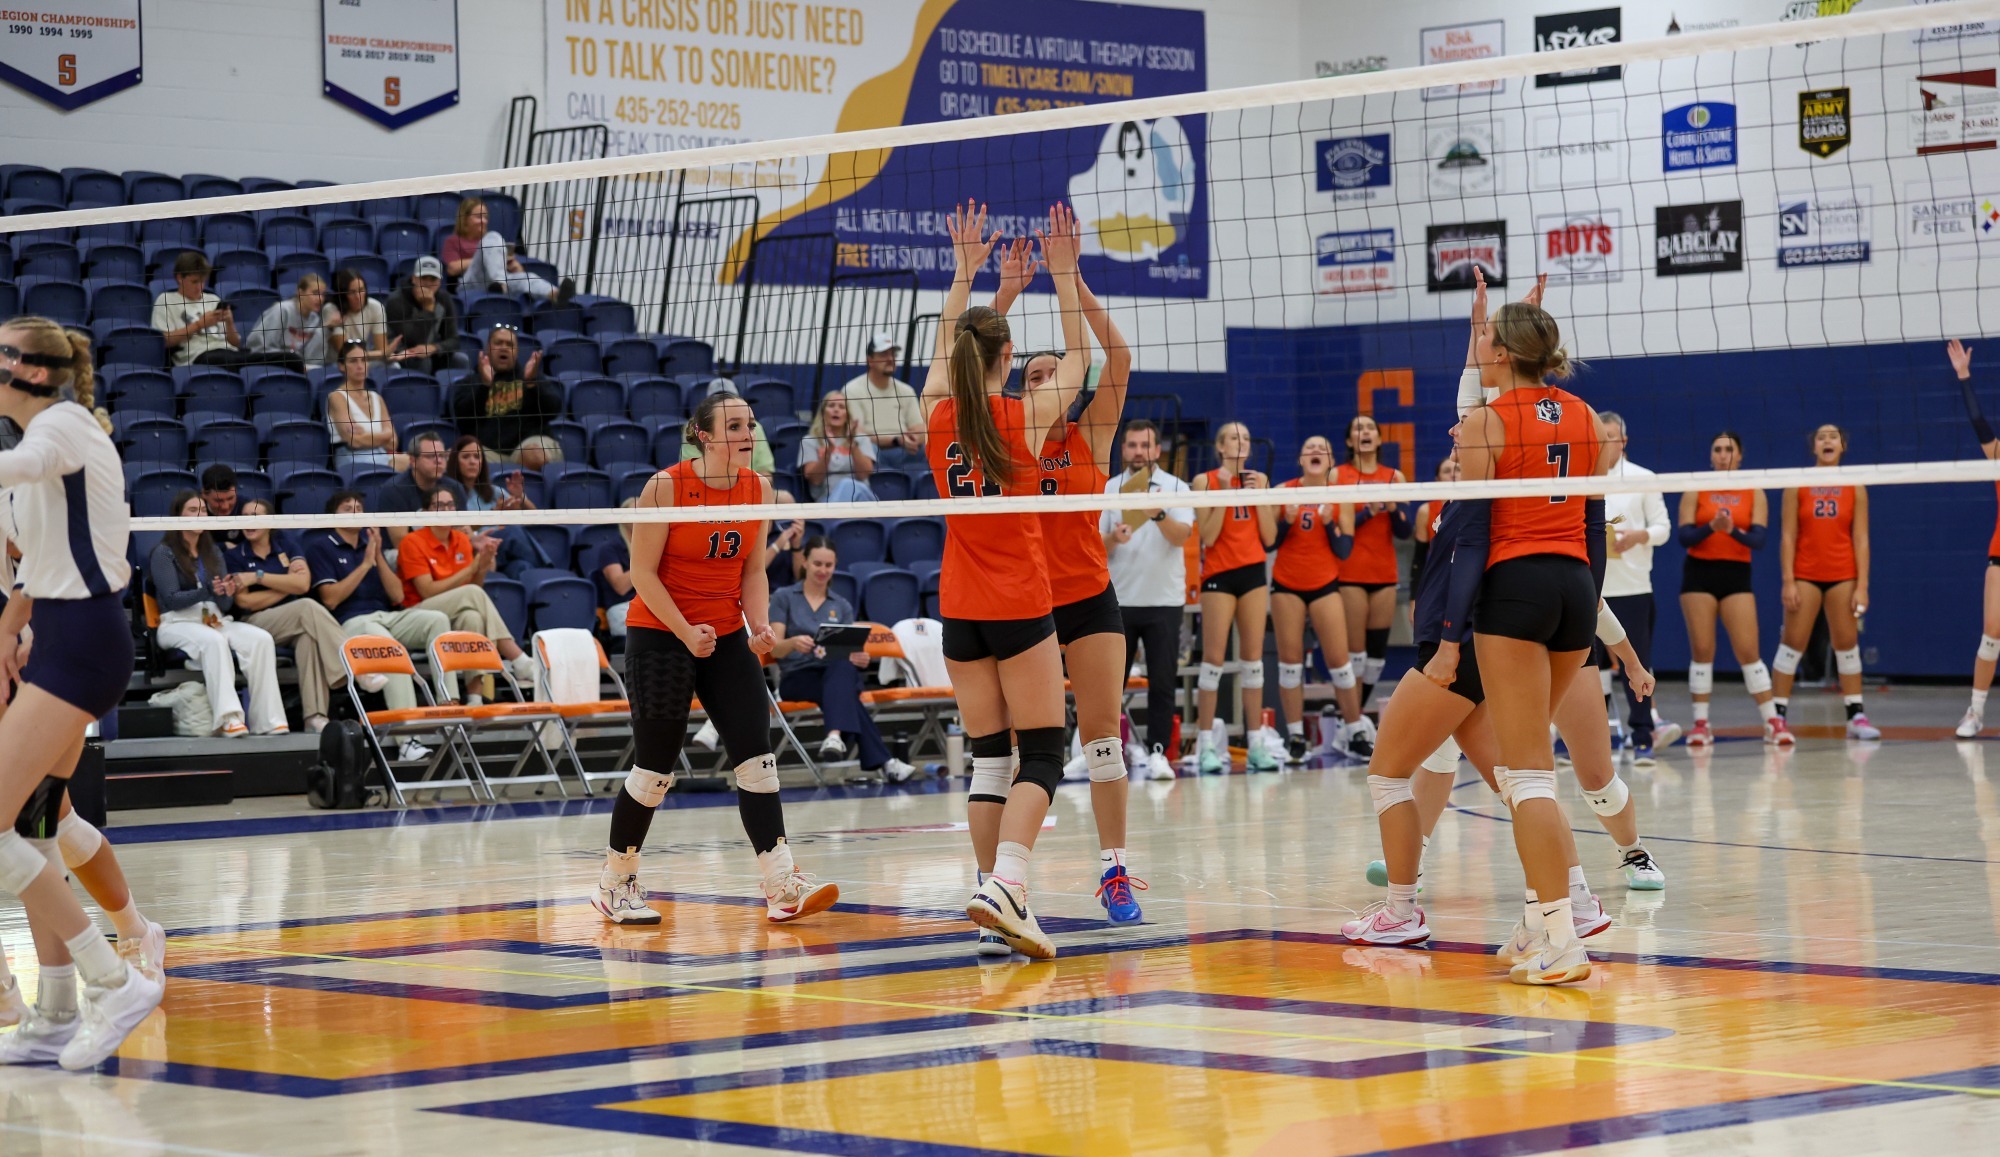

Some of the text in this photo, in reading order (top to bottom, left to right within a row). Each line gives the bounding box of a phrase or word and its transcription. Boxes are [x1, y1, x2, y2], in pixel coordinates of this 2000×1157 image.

[9, 24, 94, 39] 1990 1994 1995
[41, 13, 137, 30] CHAMPIONSHIPS
[598, 0, 615, 26] A
[621, 0, 700, 32] CRISIS
[706, 0, 740, 37] OR
[745, 1, 798, 41] JUST
[805, 6, 864, 46] NEED
[328, 34, 454, 54] REGION CHAMPIONSHIPS
[940, 28, 1195, 71] TO SCHEDULE A VIRTUAL THERAPY SESSION
[58, 54, 77, 86] S
[565, 36, 837, 95] TO TALK TO SOMEONE?
[940, 60, 1134, 97] GO TO TIMELYCARE.COM/SNOW
[384, 76, 401, 107] S
[567, 92, 742, 131] CALL 435-252-0225
[940, 92, 959, 116] OR
[960, 93, 989, 118] CALL
[1804, 101, 1844, 116] ARMY
[1803, 123, 1847, 139] GUARD
[835, 207, 861, 232] ALL
[862, 209, 914, 234] MENTAL
[915, 211, 960, 236] HEALT
[1782, 211, 1808, 235] SN
[1547, 224, 1613, 260] ROYS
[1657, 229, 1739, 259] BARCLAY
[836, 244, 870, 268] FREE
[871, 244, 897, 269] FOR
[898, 245, 937, 270] SNOW
[1547, 443, 1570, 504] 7
[1301, 512, 1313, 531] 5
[1814, 499, 1837, 518] 23
[704, 530, 742, 560] 13
[440, 641, 493, 653] BADGERS
[866, 632, 896, 644] GERS
[350, 646, 403, 659] BADGERS
